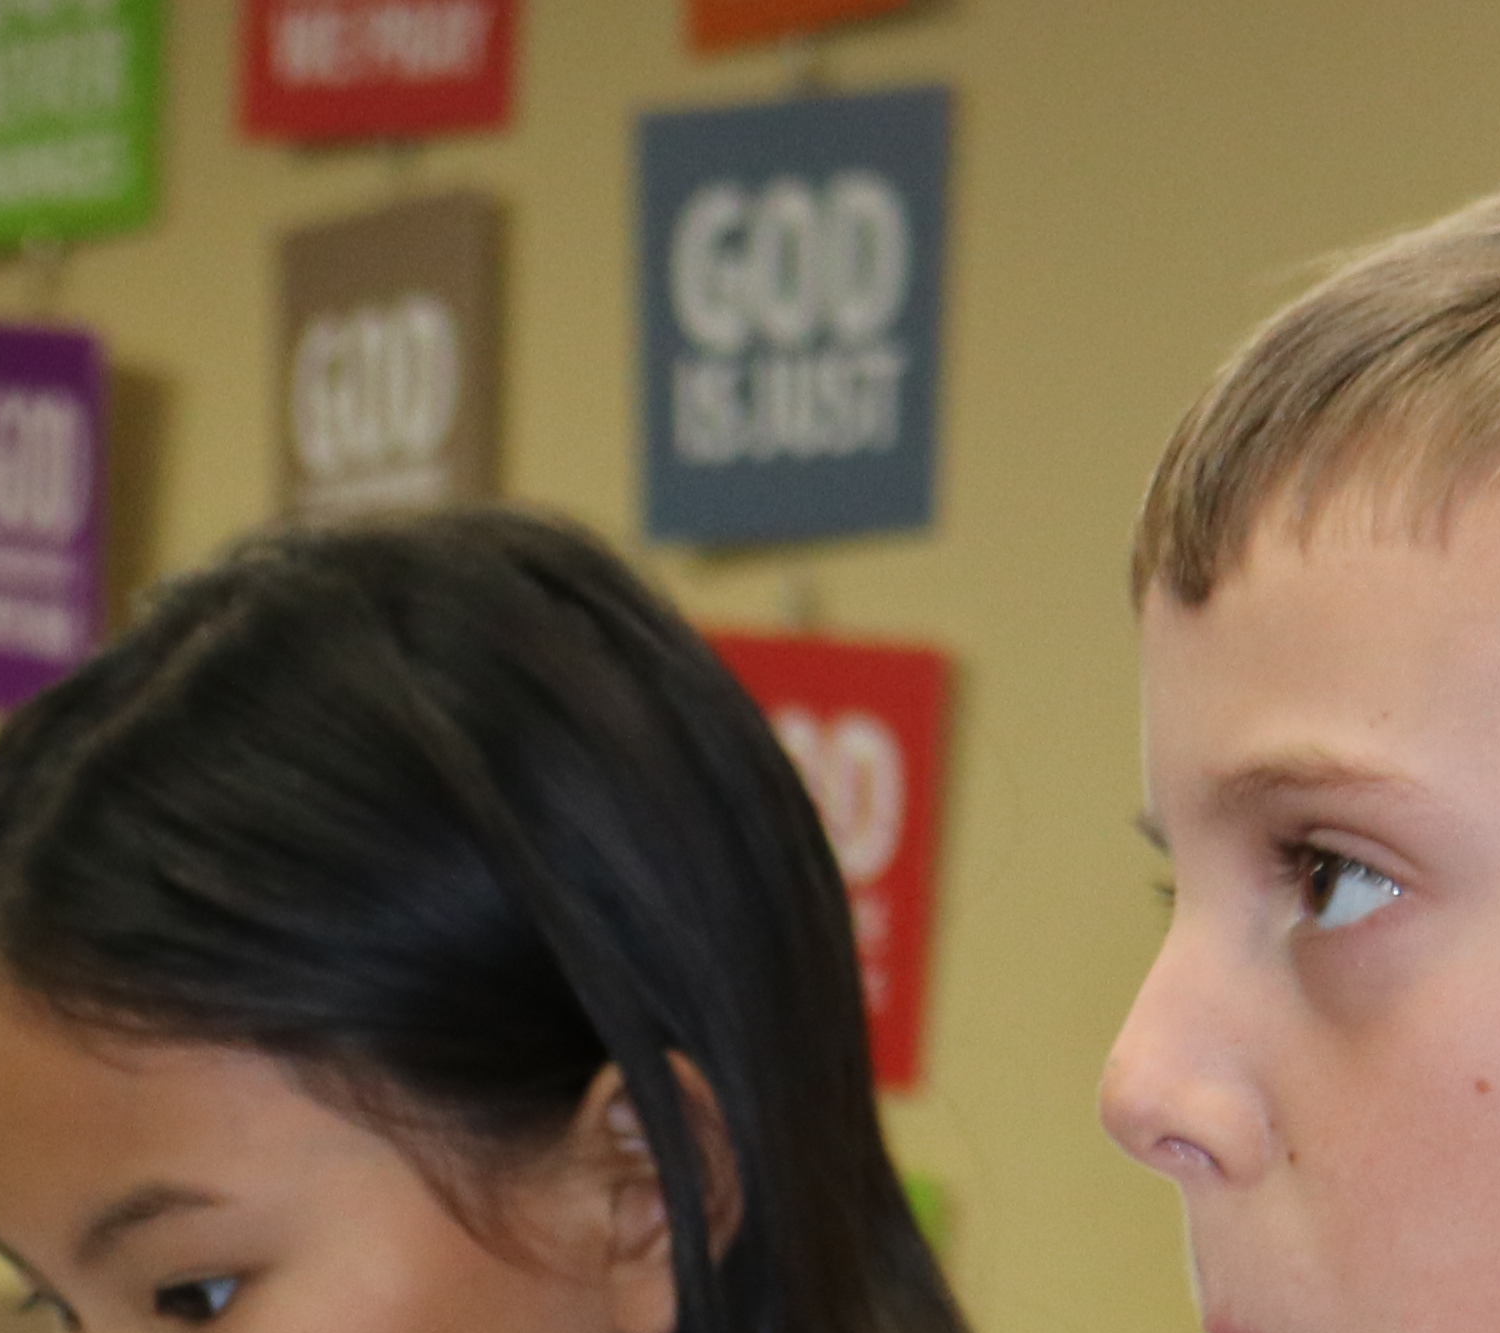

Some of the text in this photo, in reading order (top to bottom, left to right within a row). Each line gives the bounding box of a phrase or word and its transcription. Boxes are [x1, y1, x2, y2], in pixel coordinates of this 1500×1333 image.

[670, 168, 912, 356] GOD
[293, 295, 460, 474] GOD
[675, 347, 908, 466] IS JUST
